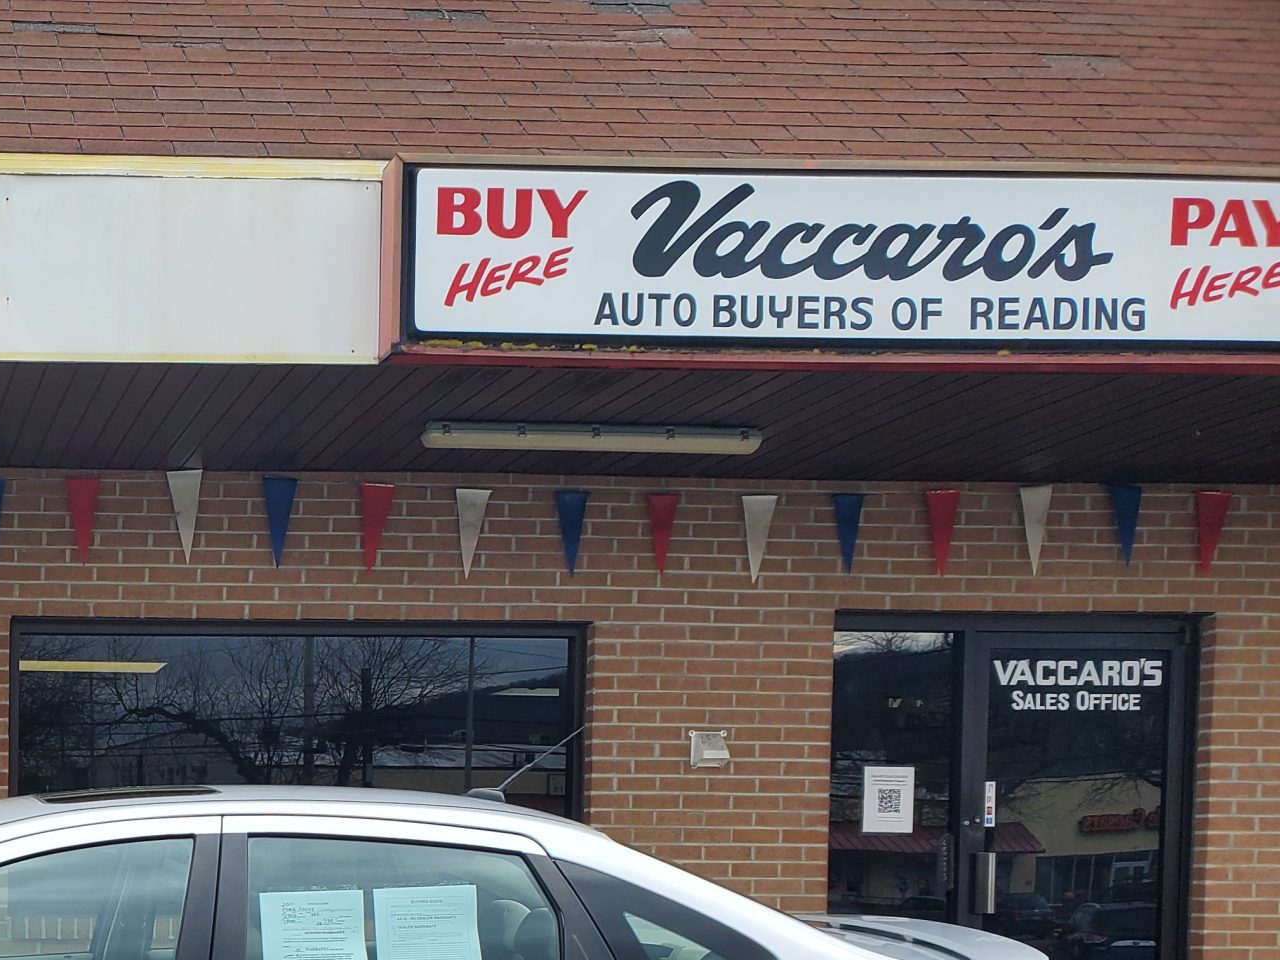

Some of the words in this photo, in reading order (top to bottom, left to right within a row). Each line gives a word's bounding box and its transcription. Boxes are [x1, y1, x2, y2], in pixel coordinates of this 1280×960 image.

[436, 187, 587, 240] BUY
[630, 180, 1114, 282] Vaccaro's
[1169, 197, 1280, 248] PAY
[444, 247, 572, 307] HERE
[1169, 261, 1280, 310] HERE
[593, 292, 697, 327] AUTO
[712, 294, 874, 331] BUYERS
[891, 297, 943, 331] OF
[970, 297, 1146, 332] READING
[993, 657, 1163, 687] VACCARO'S
[1011, 690, 1070, 711] SALES
[1075, 690, 1142, 711] OFFICE
